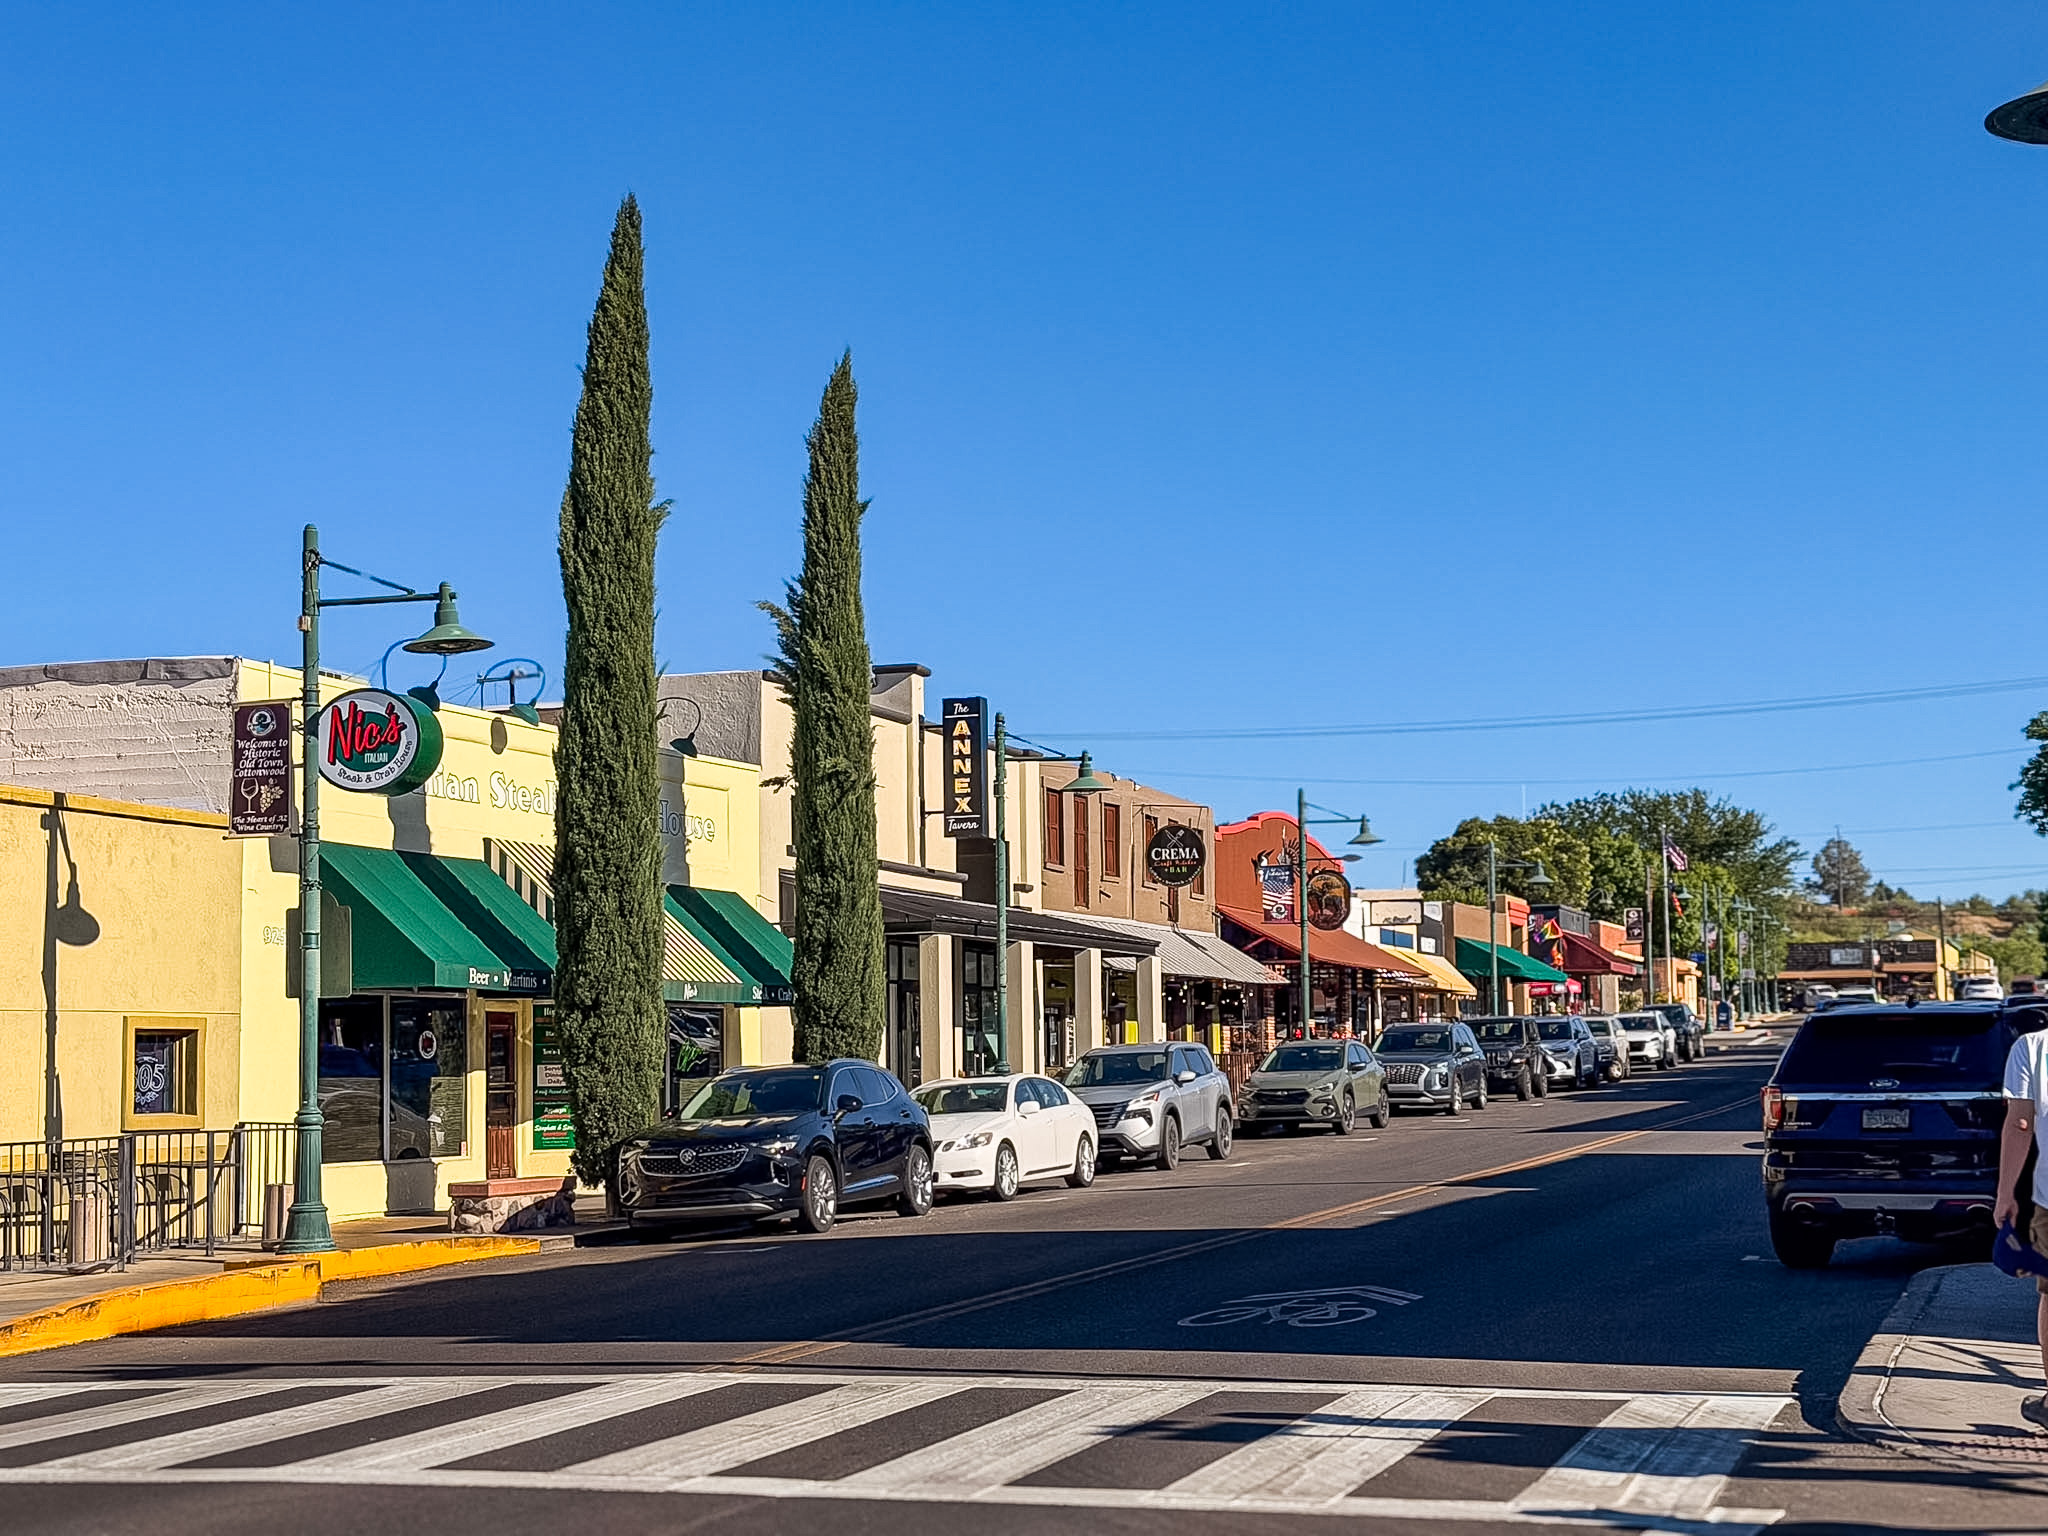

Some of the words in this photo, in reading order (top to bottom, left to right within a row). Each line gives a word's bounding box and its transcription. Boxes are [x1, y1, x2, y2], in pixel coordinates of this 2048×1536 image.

[953, 703, 969, 714] The
[327, 700, 407, 766] Nic's
[236, 738, 276, 749] Welcome
[278, 738, 288, 747] to
[242, 749, 281, 759] Historic
[364, 752, 388, 764] ITALIAN
[240, 758, 256, 768] Old
[258, 759, 284, 768] Town
[365, 774, 373, 783] &
[374, 765, 396, 781] Crab
[393, 740, 413, 768] House
[952, 720, 972, 813] ANNEX
[234, 765, 287, 777] Cottonwood
[247, 816, 268, 825] Heart
[269, 815, 276, 825] of
[948, 819, 979, 831] Tavern
[256, 823, 284, 831] Country
[1151, 847, 1200, 861] CREMA
[468, 967, 490, 985] Beer
[503, 970, 537, 988] Martinis
[134, 1063, 165, 1092] 05
